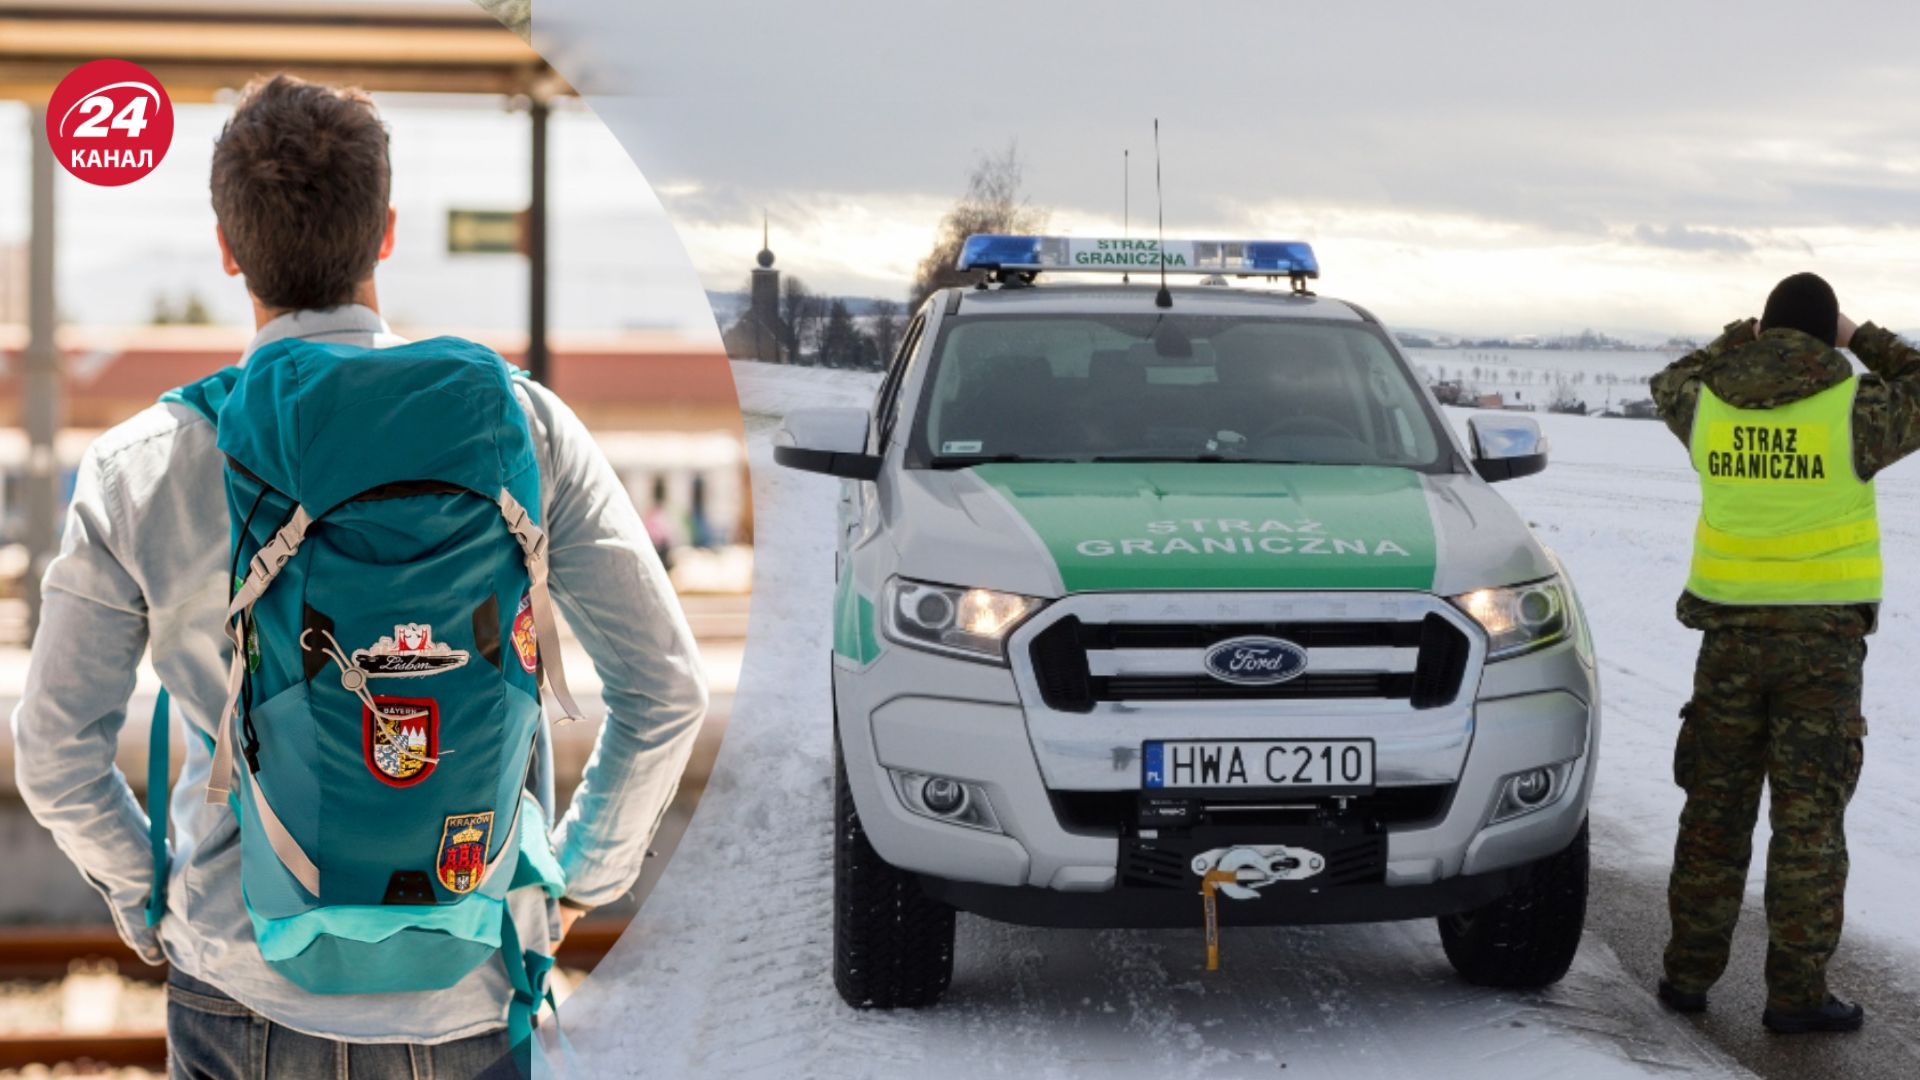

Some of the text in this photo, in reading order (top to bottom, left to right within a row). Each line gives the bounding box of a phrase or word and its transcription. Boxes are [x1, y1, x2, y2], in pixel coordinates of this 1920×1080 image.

[1075, 251, 1187, 266] GRANICZNA
[1708, 450, 1826, 480] GRANICZNA
[1075, 537, 1411, 557] GRANICZNA
[379, 655, 431, 671] Lisbon
[1229, 649, 1283, 672] Ford
[383, 706, 418, 716] BAYERN
[1172, 746, 1362, 784] HWA C210
[1147, 771, 1161, 781] PL
